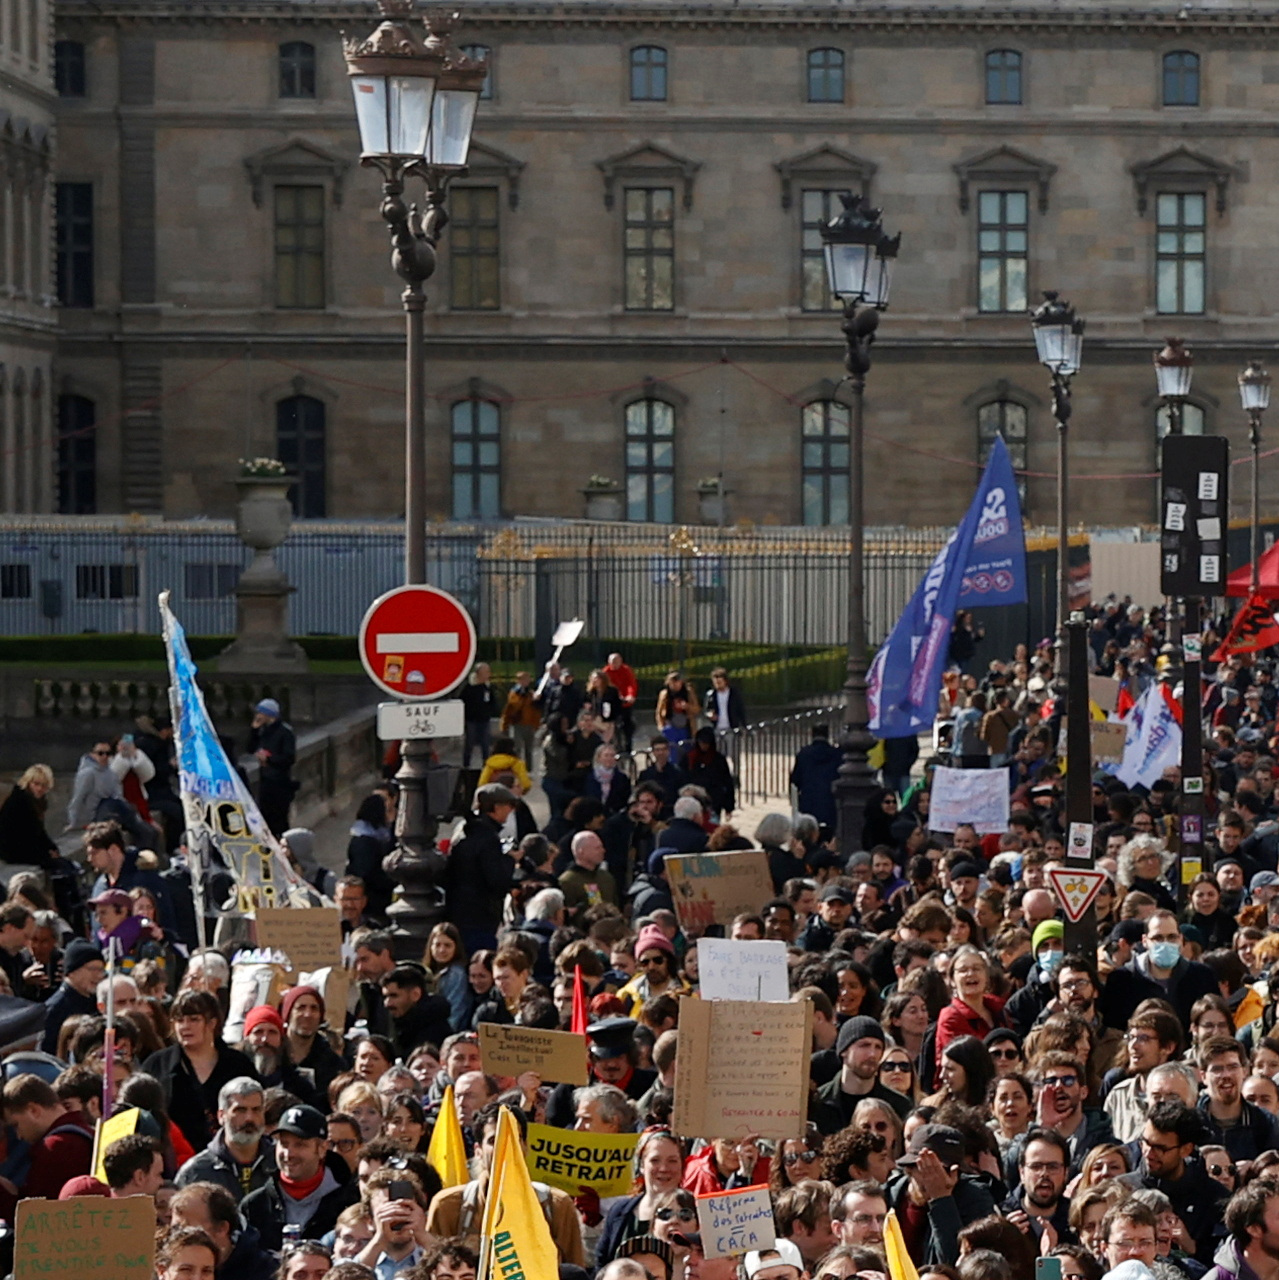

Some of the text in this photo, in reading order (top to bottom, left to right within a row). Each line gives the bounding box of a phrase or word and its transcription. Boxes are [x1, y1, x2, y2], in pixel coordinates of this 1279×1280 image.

[405, 706, 440, 717] SAUF
[530, 1138, 636, 1164] JUSQU'AU
[535, 1156, 627, 1181] RETRAIT
[708, 1196, 755, 1215] Réforme
[21, 1202, 132, 1237] ARRÊTEZ
[713, 1215, 732, 1229] des
[51, 1237, 102, 1253] NOUS
[717, 1232, 758, 1252] CACA
